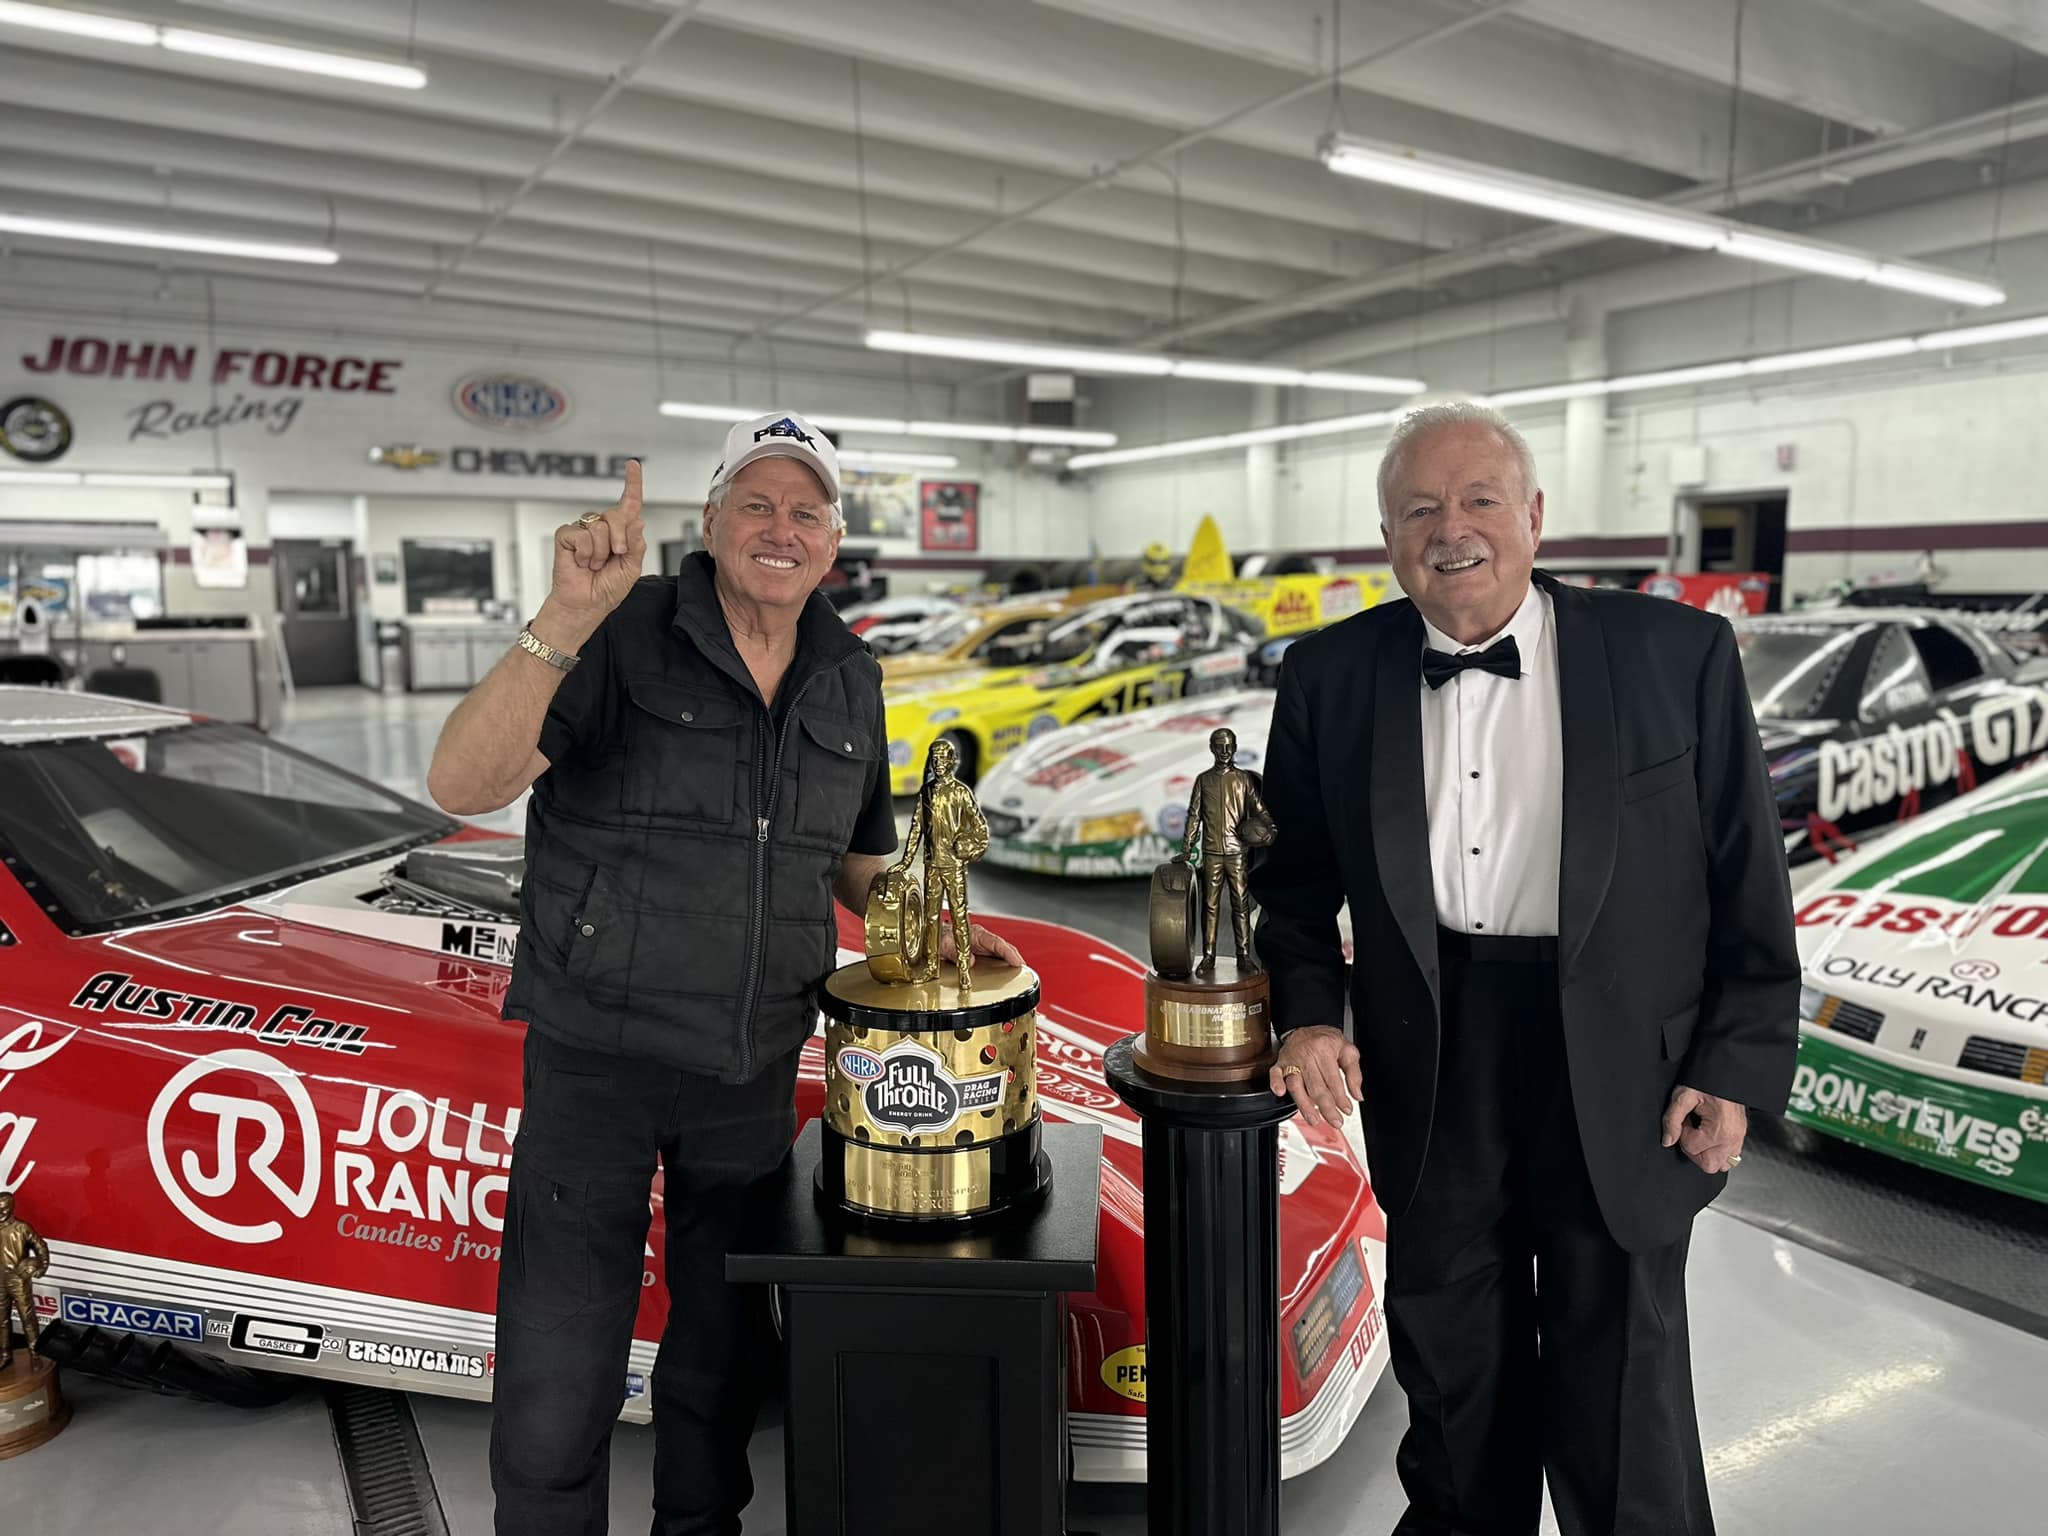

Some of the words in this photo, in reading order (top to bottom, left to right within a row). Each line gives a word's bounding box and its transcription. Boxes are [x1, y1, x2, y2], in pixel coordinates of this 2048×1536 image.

[21, 335, 197, 383] JOHN
[212, 349, 403, 395] FORCE
[127, 394, 305, 443] Racing
[754, 418, 818, 453] PEAK
[1817, 707, 1963, 822] Castrol
[844, 1056, 876, 1076] NHRA
[963, 1087, 998, 1100] RACING
[964, 1081, 990, 1092] DRAG
[1790, 1065, 1867, 1113] DON
[1869, 1090, 2023, 1163] STEVES
[336, 1213, 442, 1252] Candies
[67, 1300, 194, 1336] CRAGAR
[258, 1339, 298, 1352] GASKET
